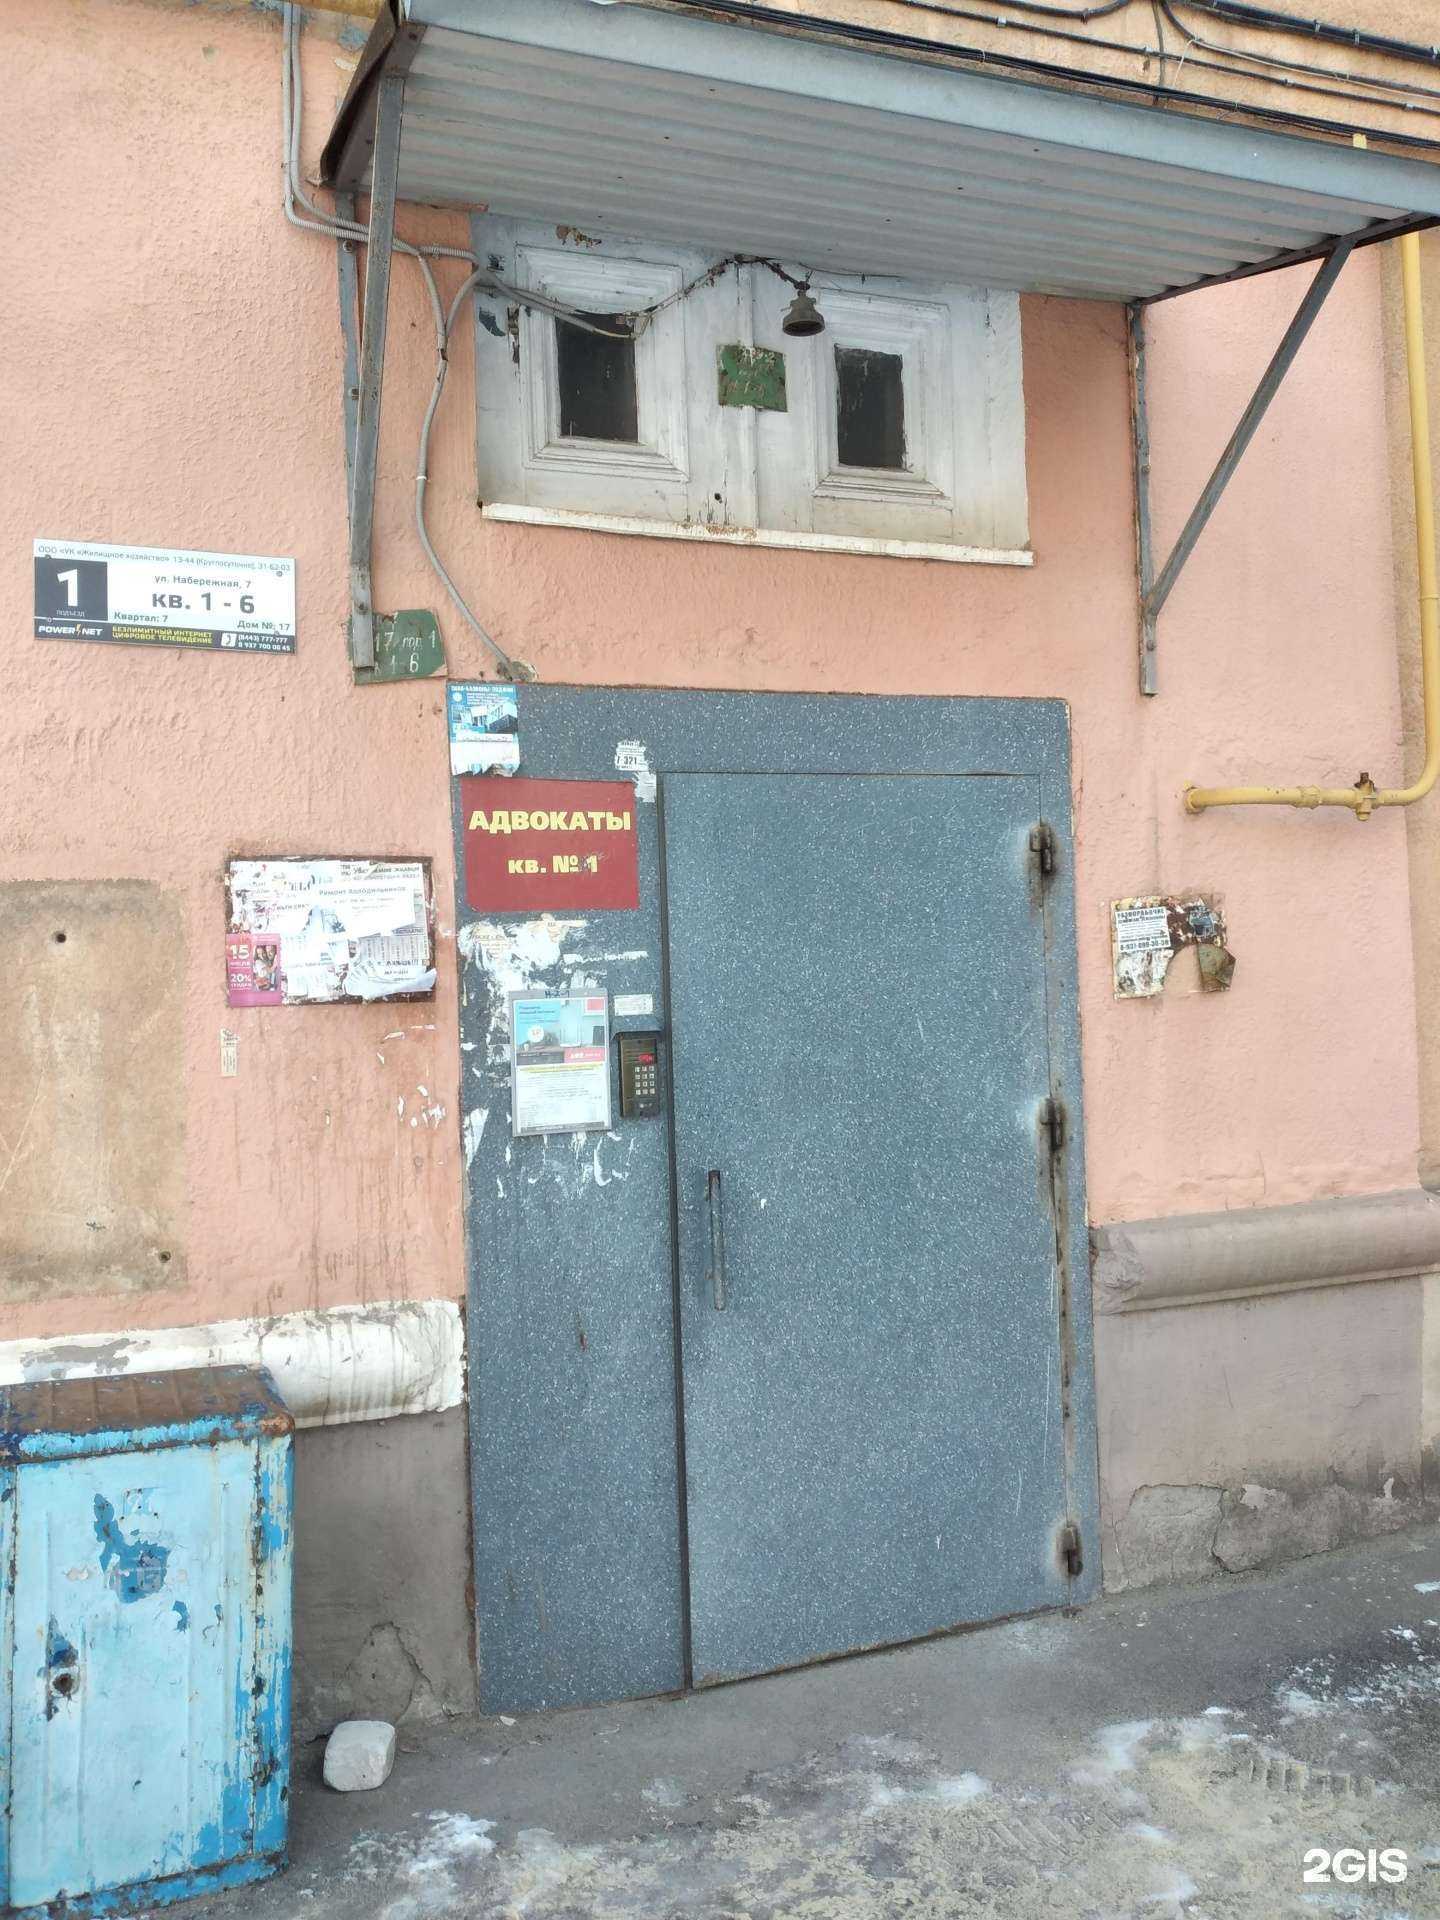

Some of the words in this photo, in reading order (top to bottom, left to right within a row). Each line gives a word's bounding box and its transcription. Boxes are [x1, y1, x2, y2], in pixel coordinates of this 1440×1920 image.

[57, 568, 78, 607] 1
[154, 575, 169, 585] ул.
[173, 575, 242, 589] Набережная,
[245, 580, 251, 588] 7
[201, 592, 211, 611] 1
[240, 595, 255, 614] 6
[114, 612, 160, 623] Квартал:
[162, 615, 169, 623] 7
[112, 626, 173, 636] БЕЗЛИМИТНЫЙ
[174, 630, 212, 638] ИНТЕРНЕТ
[237, 620, 259, 630] Дом
[279, 623, 290, 631] 17
[112, 632, 156, 641] ЦИФРОВОЕ
[159, 635, 212, 644] ТЕЛЕВИДЕНИЕ
[261, 636, 289, 644] 777-777
[468, 810, 631, 834] АДВОКАТЫ
[229, 943, 250, 960] 15
